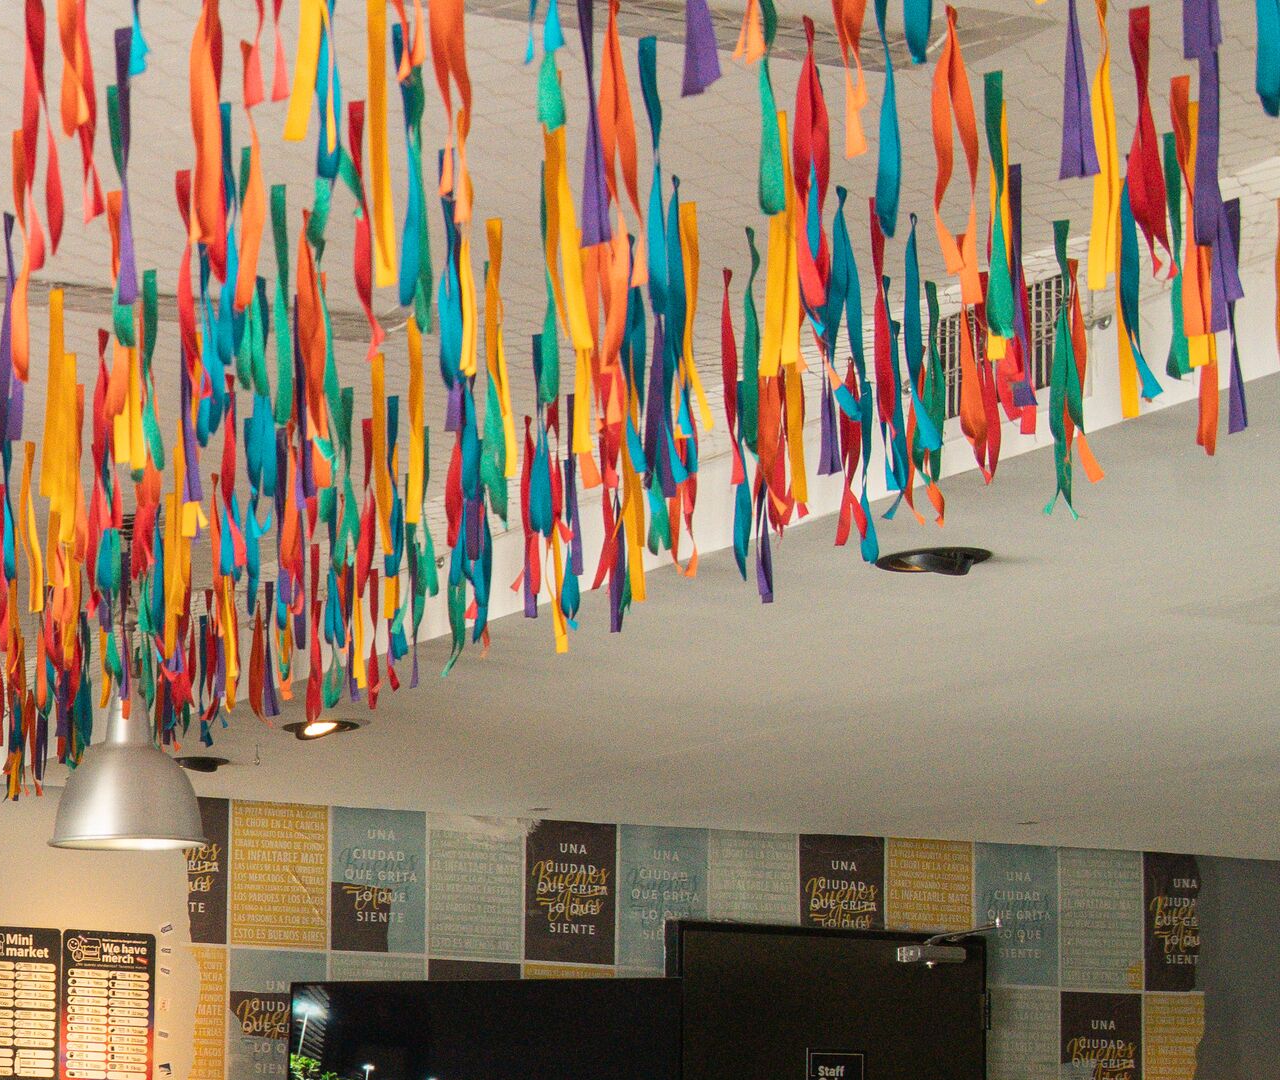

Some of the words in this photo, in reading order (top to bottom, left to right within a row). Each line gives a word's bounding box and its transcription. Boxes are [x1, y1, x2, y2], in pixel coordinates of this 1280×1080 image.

[367, 829, 396, 840] UNA
[352, 848, 406, 862] CIUDAD
[559, 842, 588, 855] UNA
[545, 863, 597, 875] CIUDAD
[831, 860, 858, 872] UNA
[344, 868, 372, 881] QUE
[377, 871, 418, 882] GRITA
[536, 881, 565, 895] QUE
[569, 884, 608, 896] GRITA
[818, 878, 866, 891] CIUDAD
[1173, 878, 1198, 889] UNA
[810, 898, 837, 910] QUE
[840, 899, 878, 912] GRITA
[356, 911, 406, 923] SIENTE
[549, 922, 596, 935] SIENTE
[5, 933, 34, 946] Mini
[5, 946, 50, 959] market
[101, 942, 120, 954] We
[121, 943, 147, 955] have
[101, 953, 135, 964] merch
[1091, 1020, 1117, 1030] UNA
[1079, 1039, 1125, 1050] CIUDAD
[817, 1065, 845, 1077] Staff
